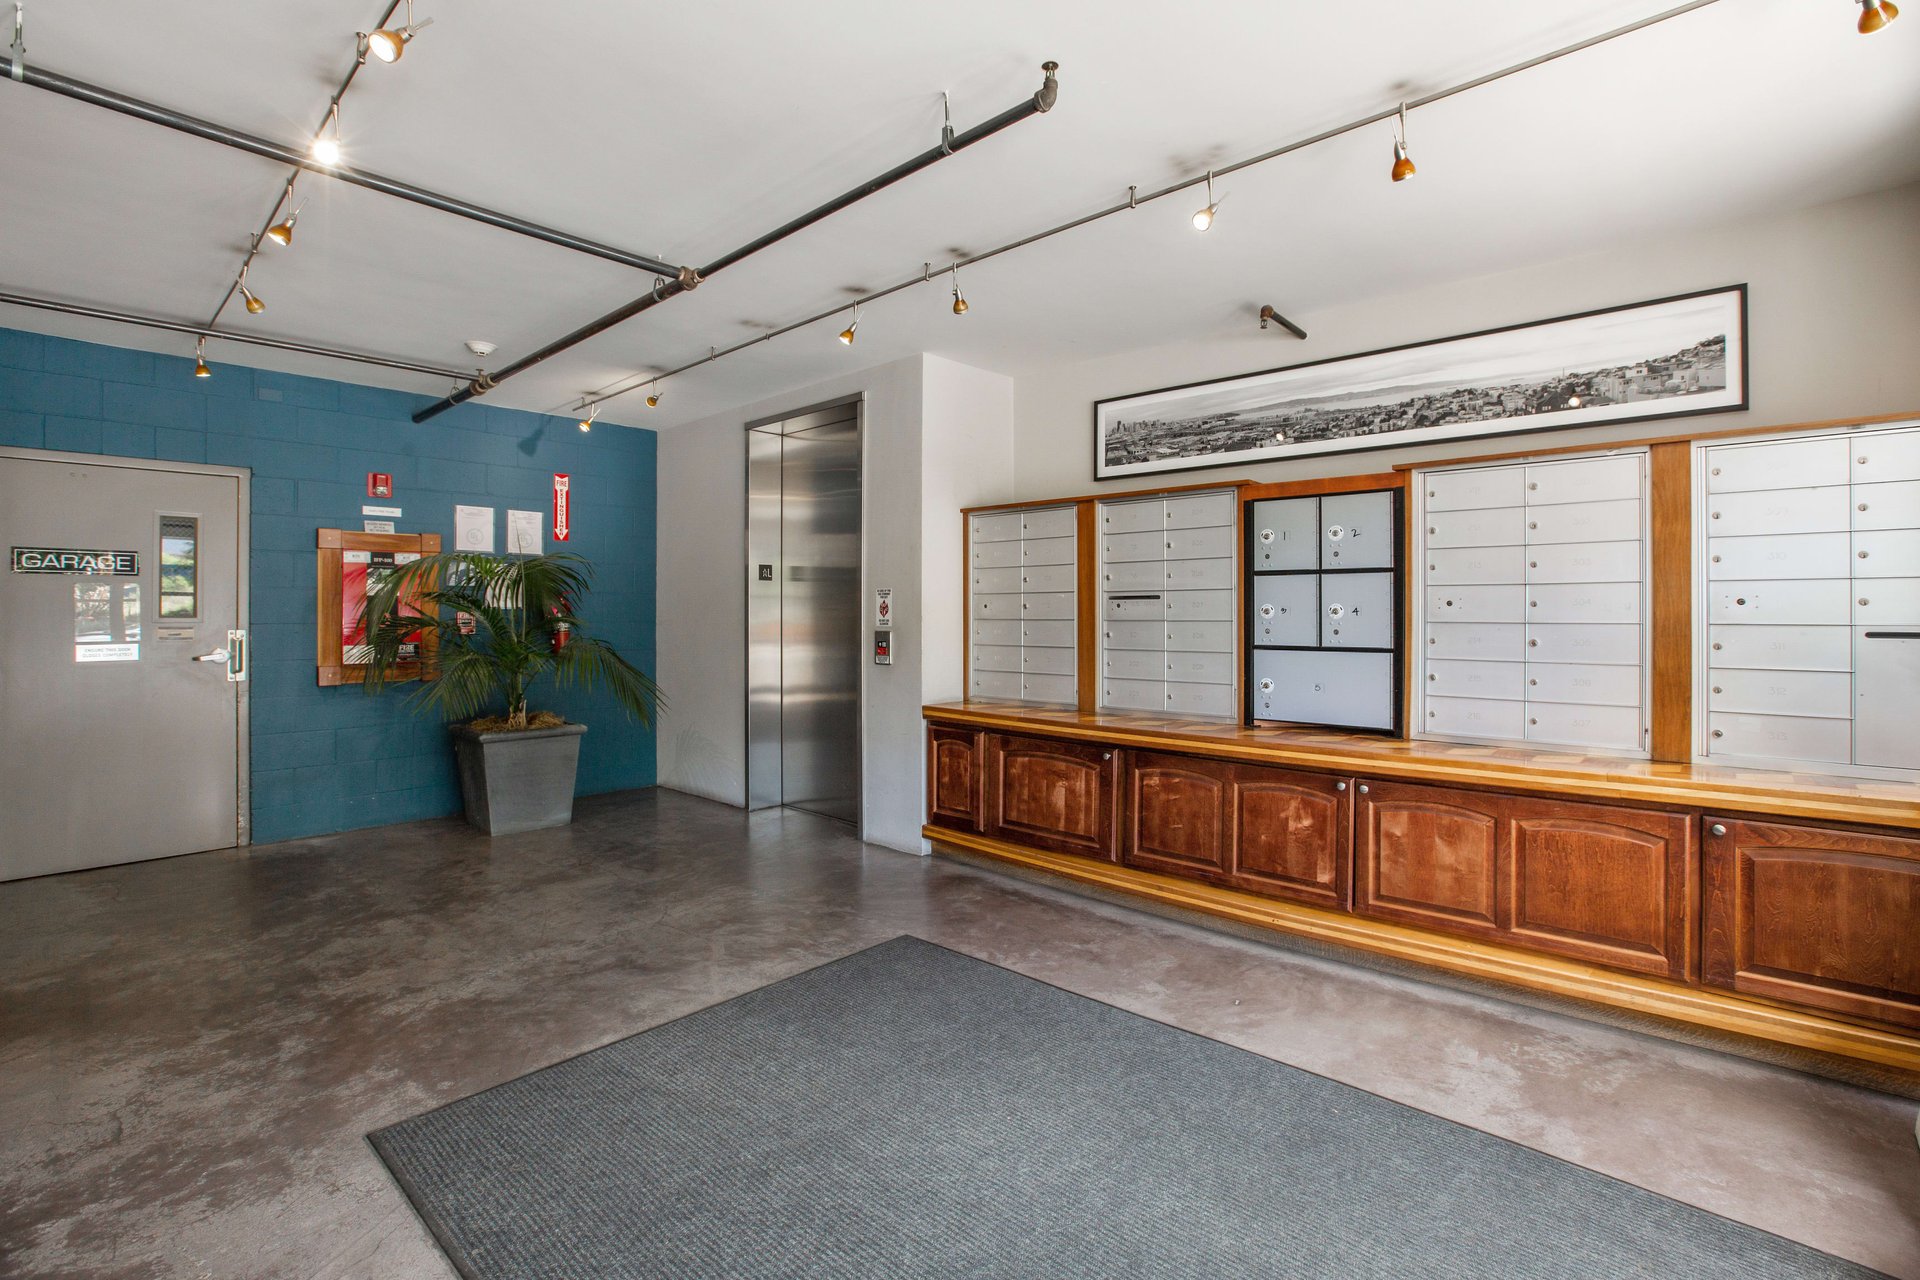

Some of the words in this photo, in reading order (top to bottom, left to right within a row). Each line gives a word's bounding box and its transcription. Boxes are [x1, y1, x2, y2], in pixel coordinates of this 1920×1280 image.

[556, 479, 567, 488] FIRE
[1350, 528, 1361, 538] 2
[1767, 551, 1788, 561] 310
[22, 553, 131, 570] GARAGE
[1351, 607, 1360, 616] 4
[1767, 685, 1788, 696] 312
[1571, 719, 1592, 728] 307
